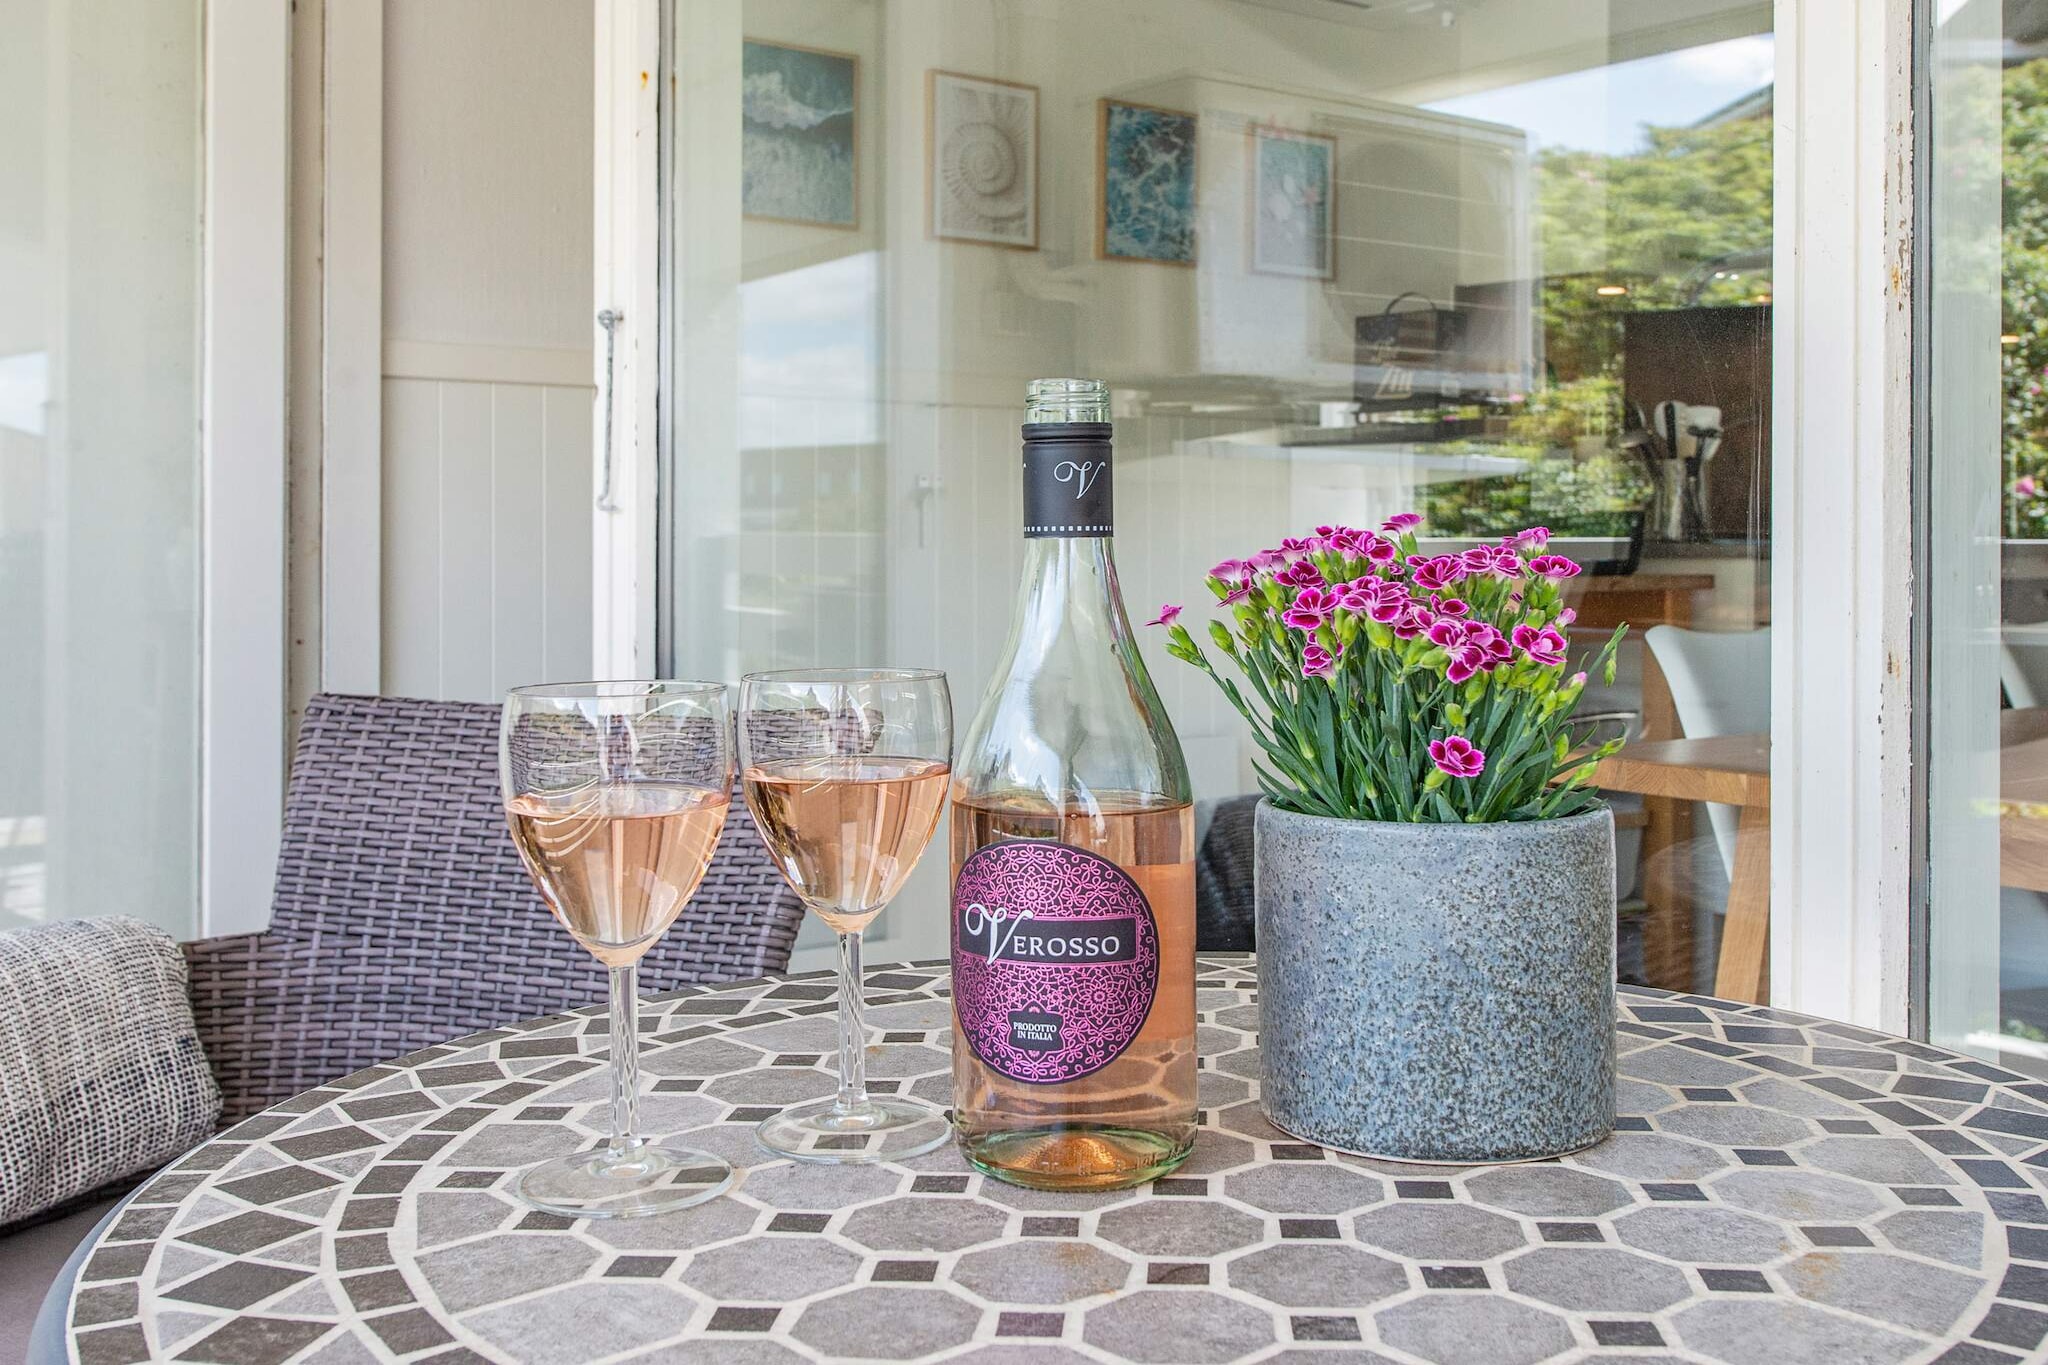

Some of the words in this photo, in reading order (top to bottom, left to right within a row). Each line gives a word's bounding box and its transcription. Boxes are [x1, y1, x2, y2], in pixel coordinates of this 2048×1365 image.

[965, 902, 1121, 966] VEROSSO
[1013, 1021, 1057, 1033] PRODOTTO
[1017, 1030, 1026, 1039] IN
[1027, 1031, 1053, 1041] ITALIA
